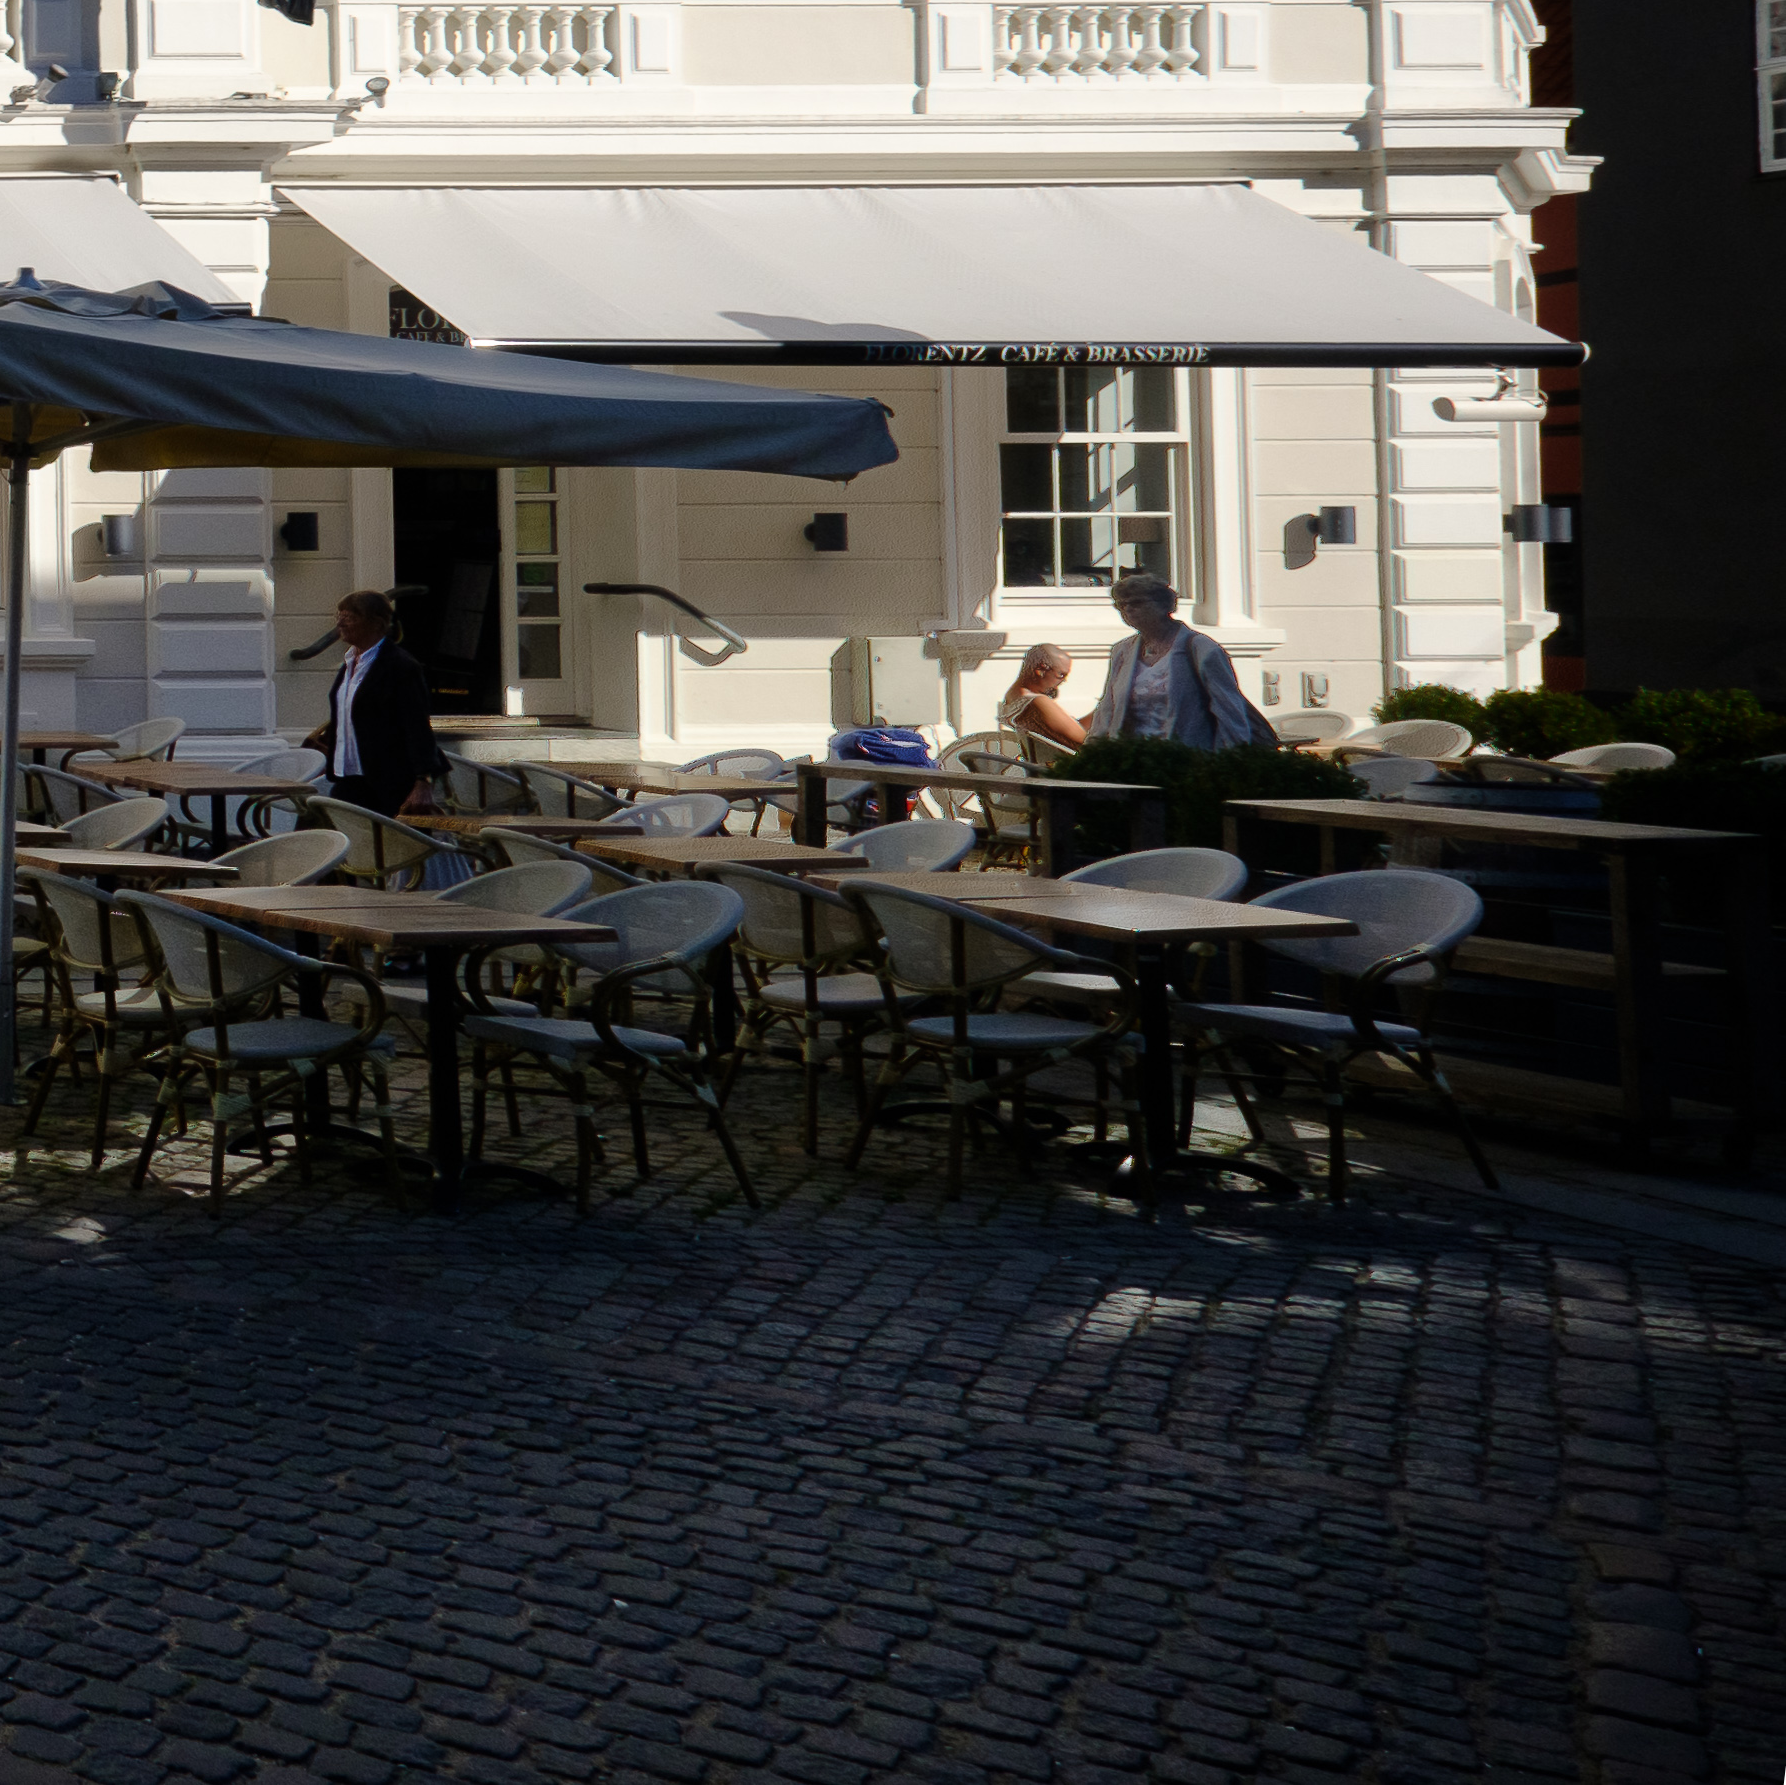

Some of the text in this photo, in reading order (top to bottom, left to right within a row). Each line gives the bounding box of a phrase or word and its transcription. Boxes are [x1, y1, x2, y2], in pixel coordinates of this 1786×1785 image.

[862, 341, 1212, 363] FLORENTZ CAFÉ & BRASSERIE
